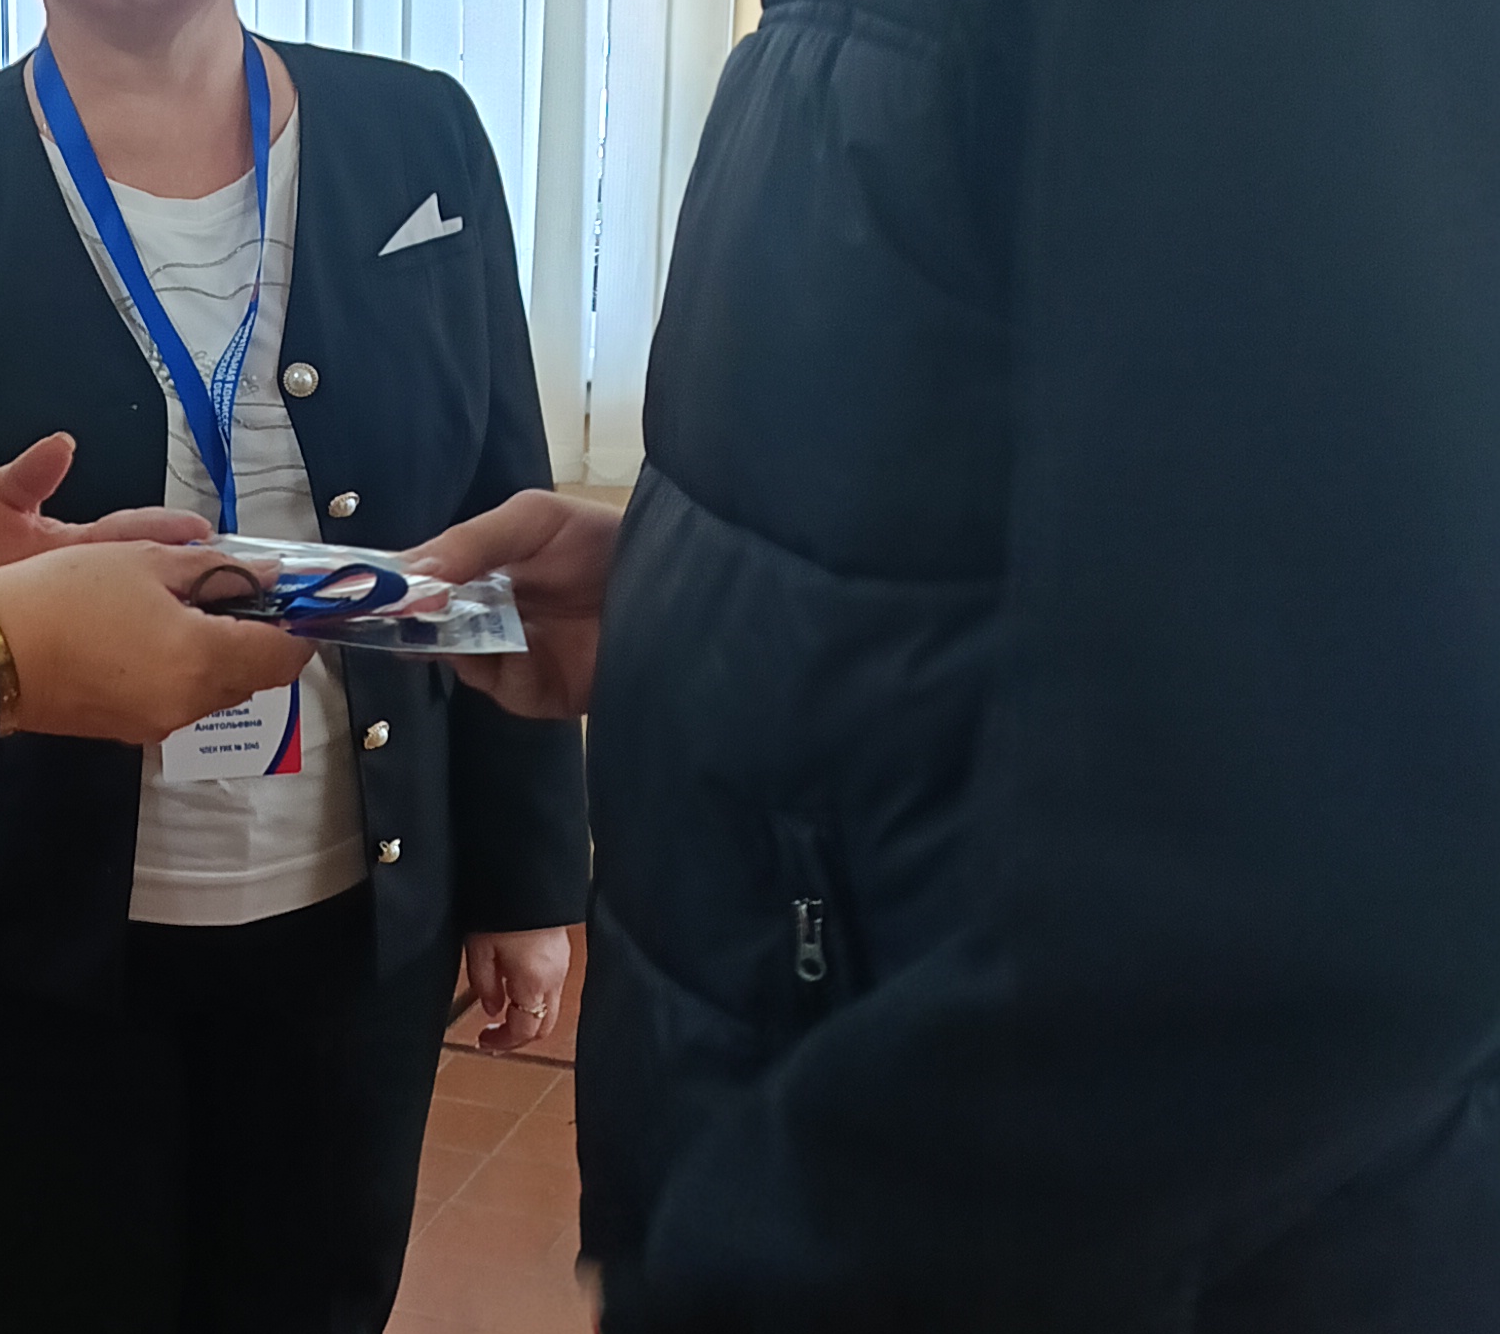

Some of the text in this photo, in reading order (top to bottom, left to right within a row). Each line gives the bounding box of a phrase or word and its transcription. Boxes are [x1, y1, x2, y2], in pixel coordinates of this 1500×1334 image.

[221, 382, 234, 440] КОМИСС
[206, 707, 250, 718] аталья
[194, 719, 263, 731] Анатольевна
